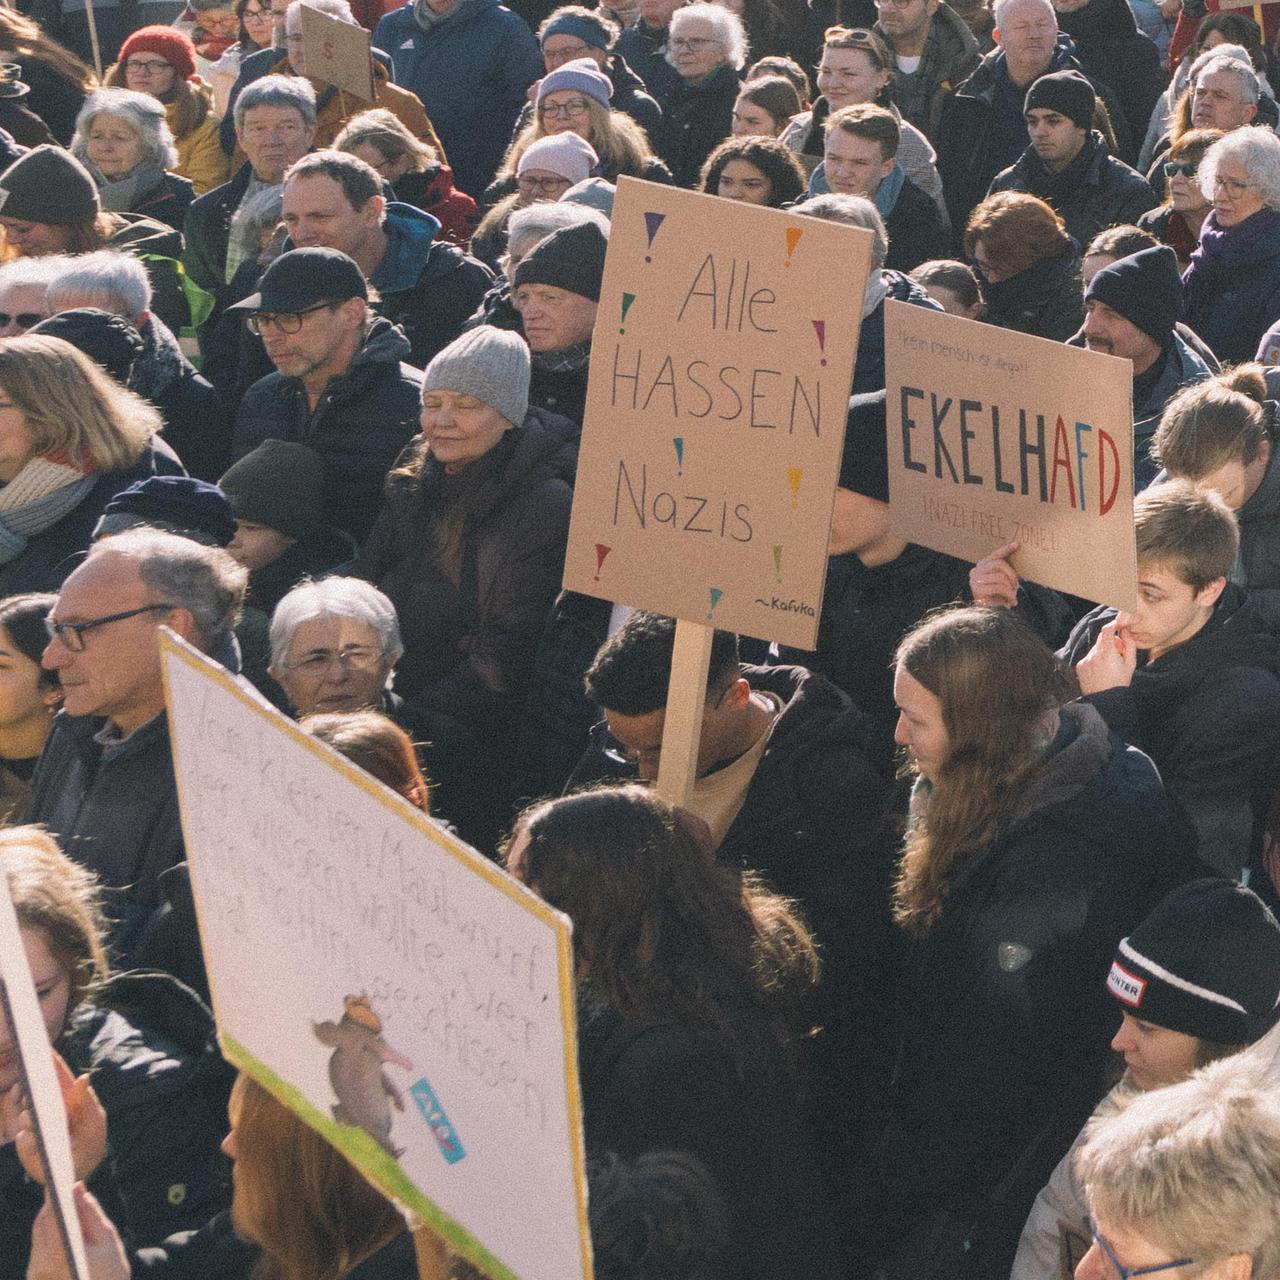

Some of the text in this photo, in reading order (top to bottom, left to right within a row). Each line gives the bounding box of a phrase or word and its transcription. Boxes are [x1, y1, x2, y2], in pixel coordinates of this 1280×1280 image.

[678, 254, 778, 333] Alle
[612, 344, 821, 438] HASSEN
[900, 386, 1121, 516] EKELHAFD
[614, 459, 754, 543] Nazis
